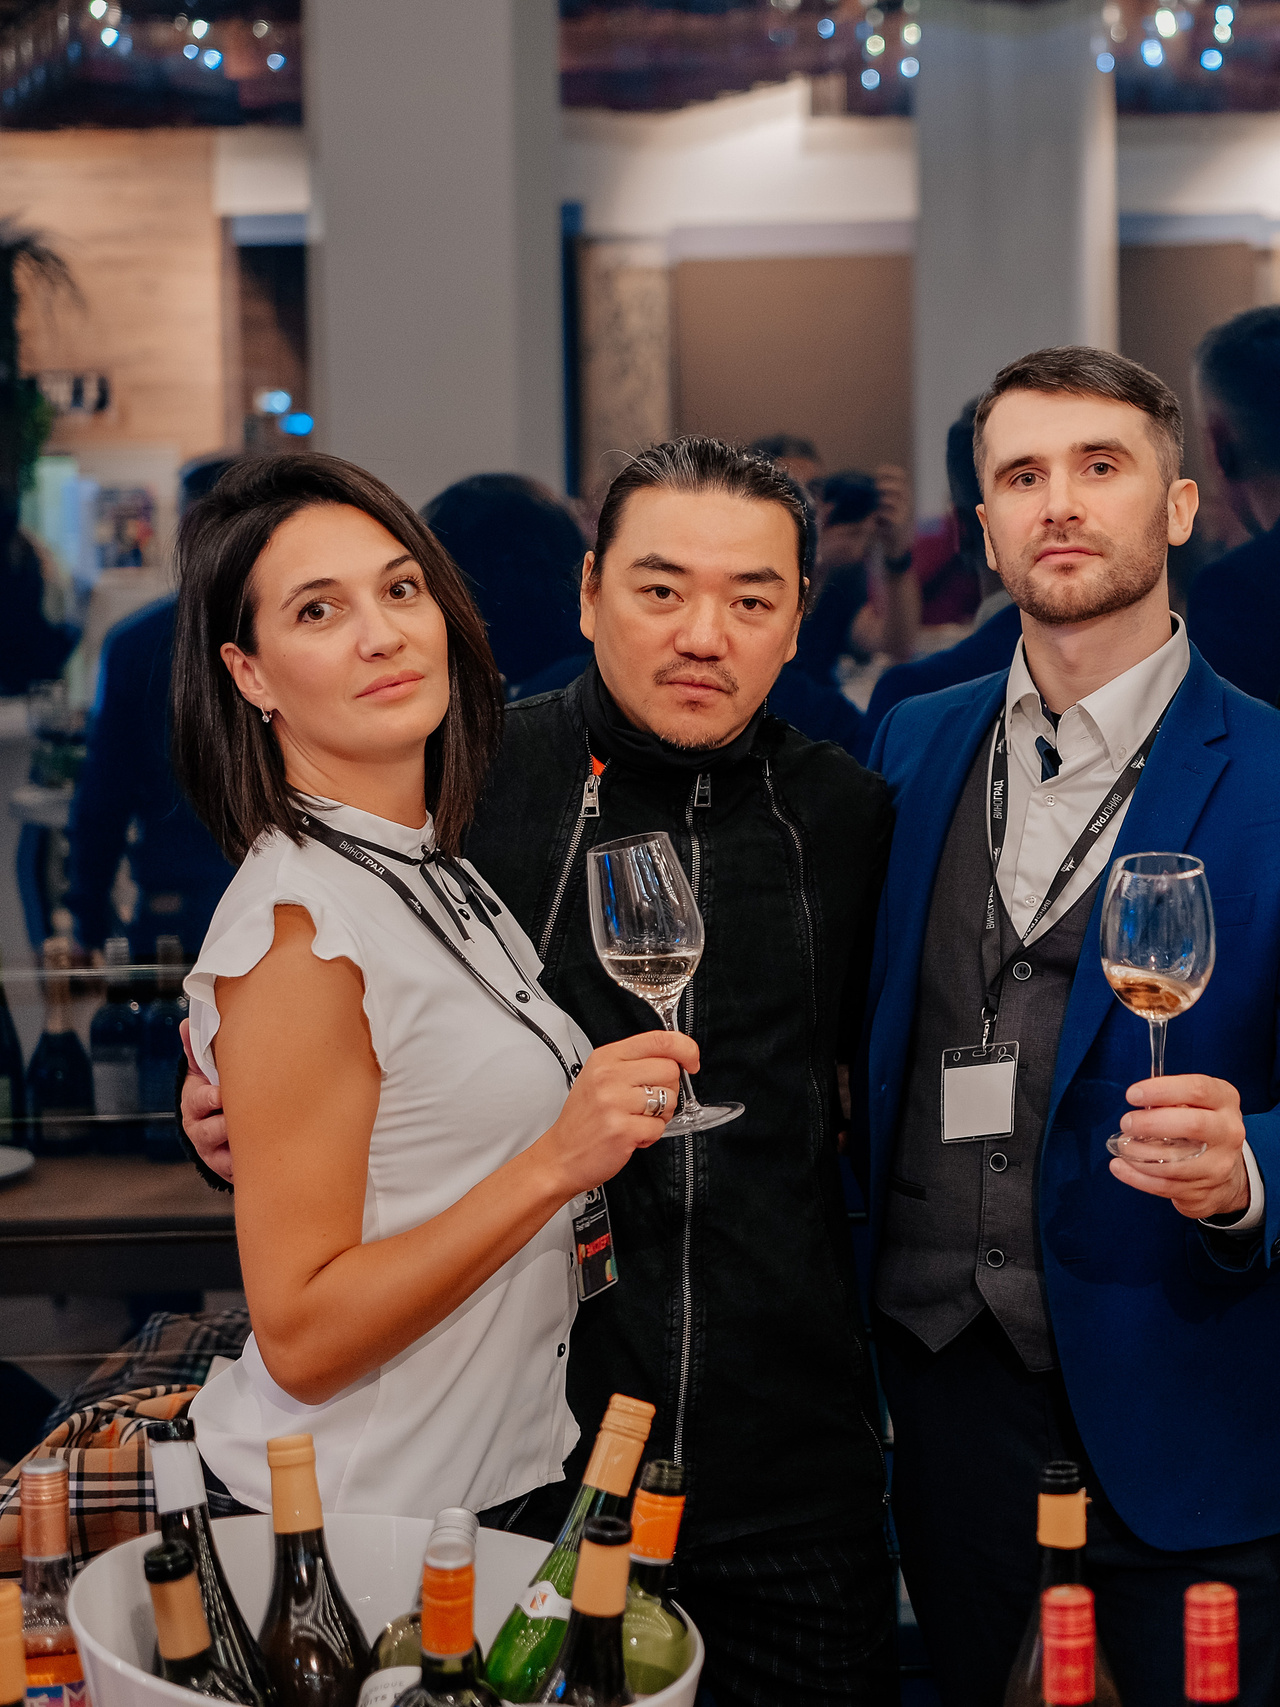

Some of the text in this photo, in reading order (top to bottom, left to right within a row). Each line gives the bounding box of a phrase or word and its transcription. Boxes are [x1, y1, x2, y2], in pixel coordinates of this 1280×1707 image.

[992, 779, 1005, 820] ВИНОГРАД
[1088, 793, 1123, 834] ВИНОГРАД
[338, 840, 386, 876] ВИНОГРАД
